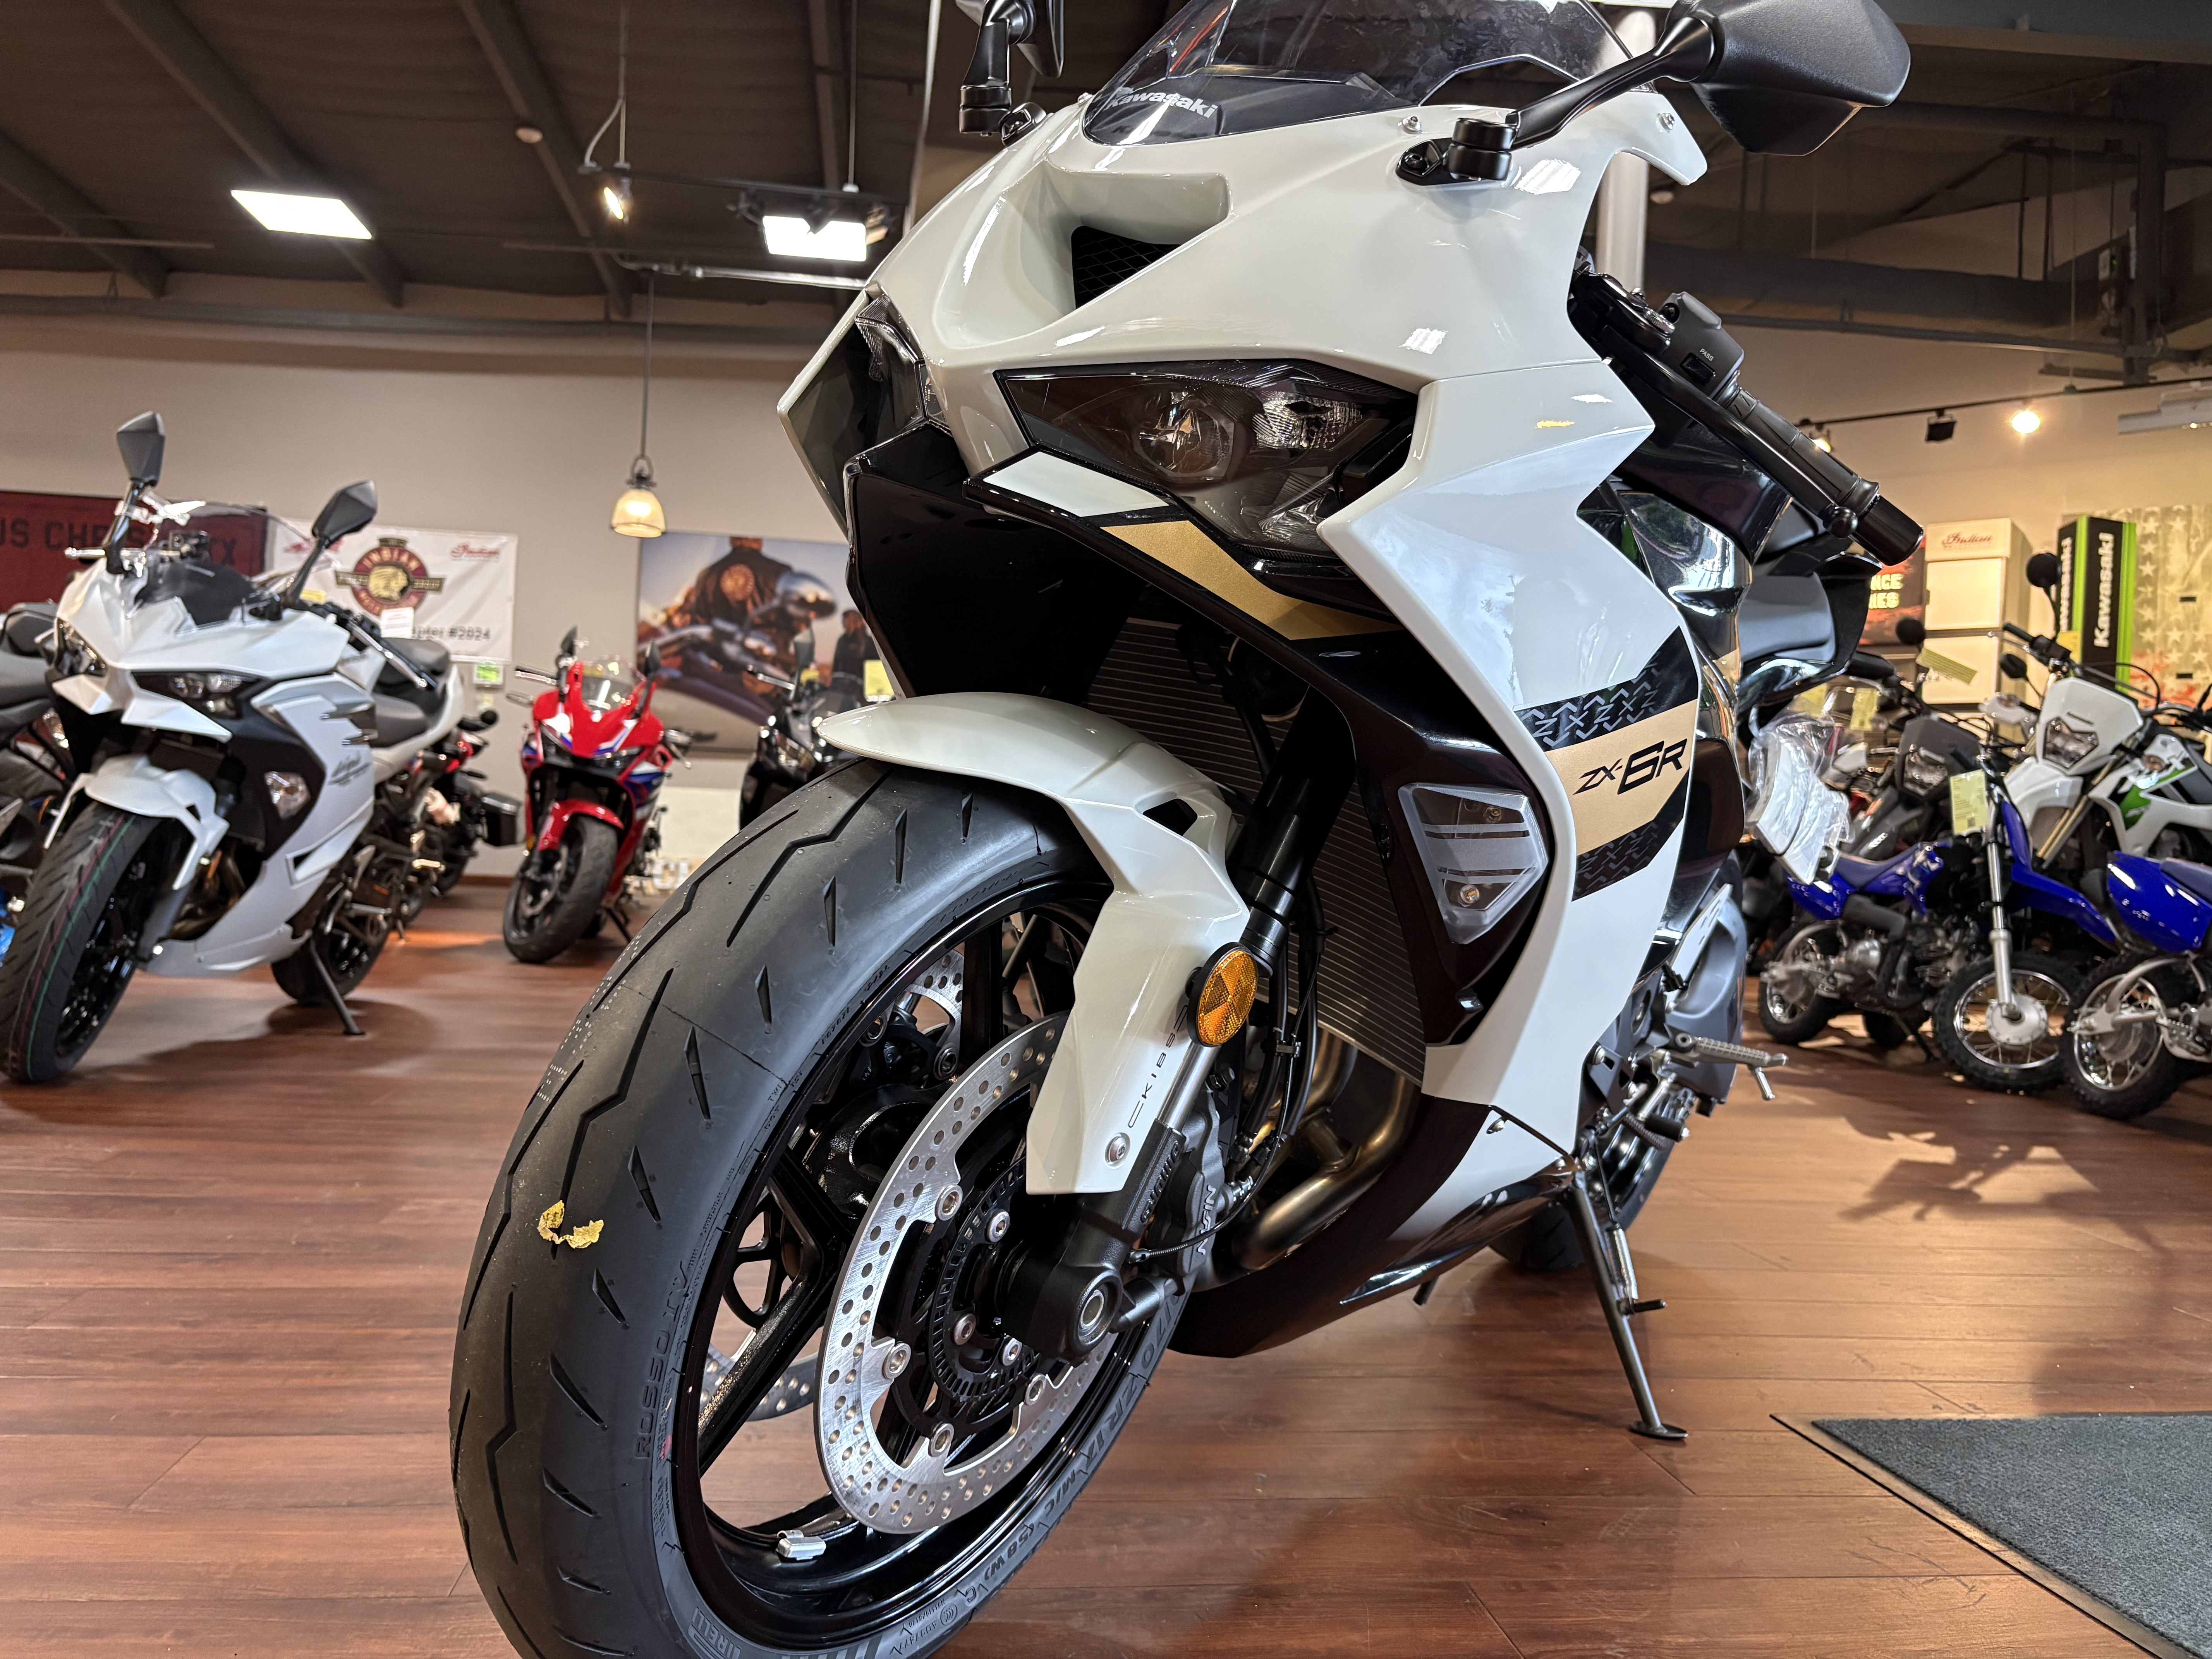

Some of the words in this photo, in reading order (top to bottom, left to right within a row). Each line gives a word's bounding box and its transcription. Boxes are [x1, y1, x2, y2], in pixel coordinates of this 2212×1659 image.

[1106, 91, 1218, 118] Kawasaki
[1700, 348, 1714, 361] PASS
[1942, 532, 1993, 547] Indian
[2094, 532, 2114, 647] Kawasaki
[1573, 738, 1688, 795] ZX-6R
[635, 1330, 671, 1458] ROSSO
[1044, 1469, 1076, 1517] M/C
